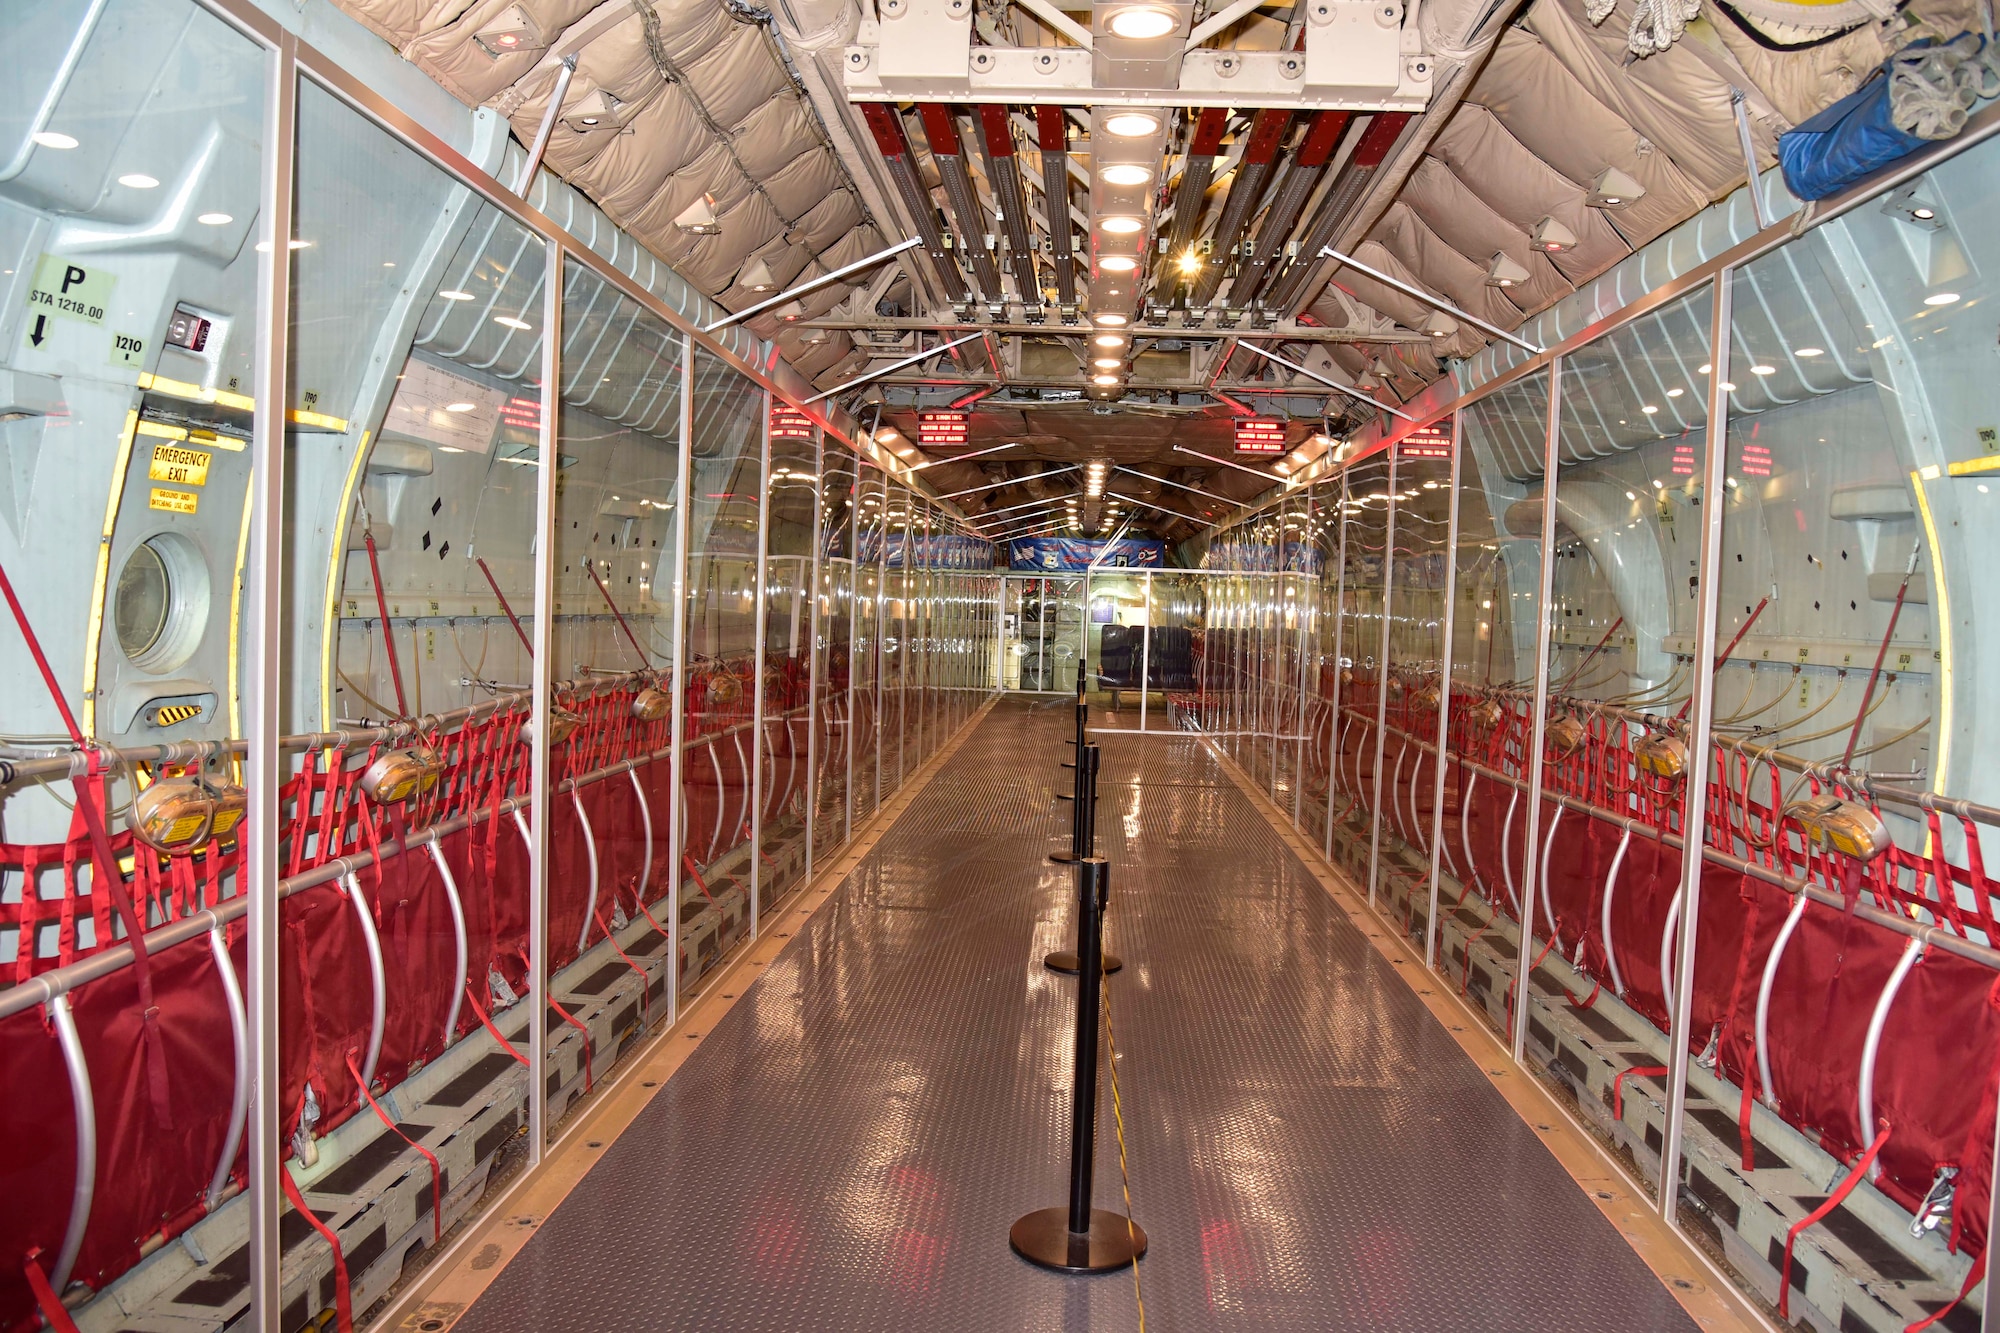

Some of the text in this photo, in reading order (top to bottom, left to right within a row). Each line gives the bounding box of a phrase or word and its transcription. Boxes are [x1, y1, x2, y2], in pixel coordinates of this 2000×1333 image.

[60, 265, 86, 294] P
[30, 289, 103, 320] STA 1218.00
[116, 335, 142, 353] 1210
[154, 447, 208, 466] EMERGENCY
[168, 467, 188, 482] EXIT
